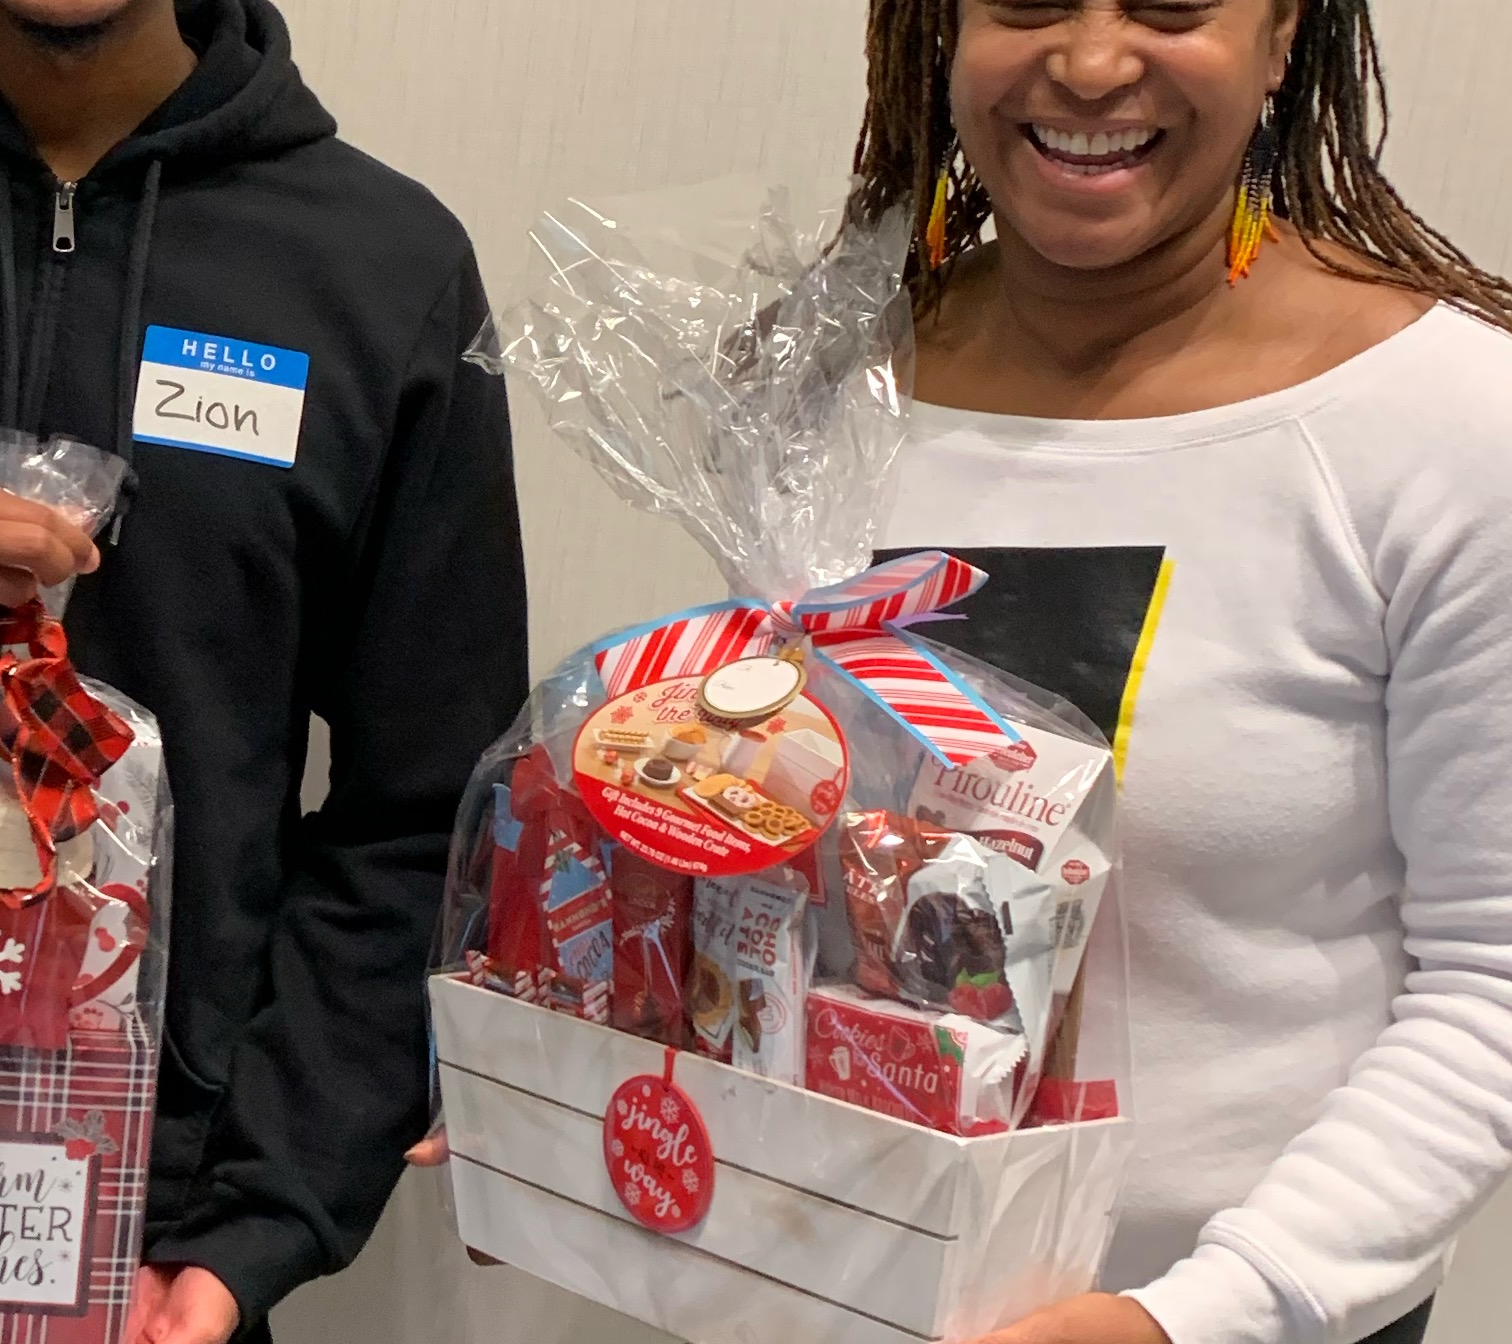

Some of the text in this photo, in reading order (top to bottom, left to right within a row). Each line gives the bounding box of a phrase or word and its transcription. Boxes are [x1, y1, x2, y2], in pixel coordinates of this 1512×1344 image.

[182, 339, 275, 370] HELLO
[200, 361, 255, 377] my name is
[155, 379, 259, 436] Zion
[656, 706, 690, 722] the
[602, 787, 621, 802] Gift
[661, 810, 702, 833] Gourmet
[700, 823, 726, 842] Food
[613, 805, 730, 856] Hot Cocoa & Wooden Crate
[979, 835, 1035, 861] Hazelnut
[867, 1052, 938, 1094] Santa
[621, 1097, 697, 1167] jingle
[623, 1159, 677, 1217] way
